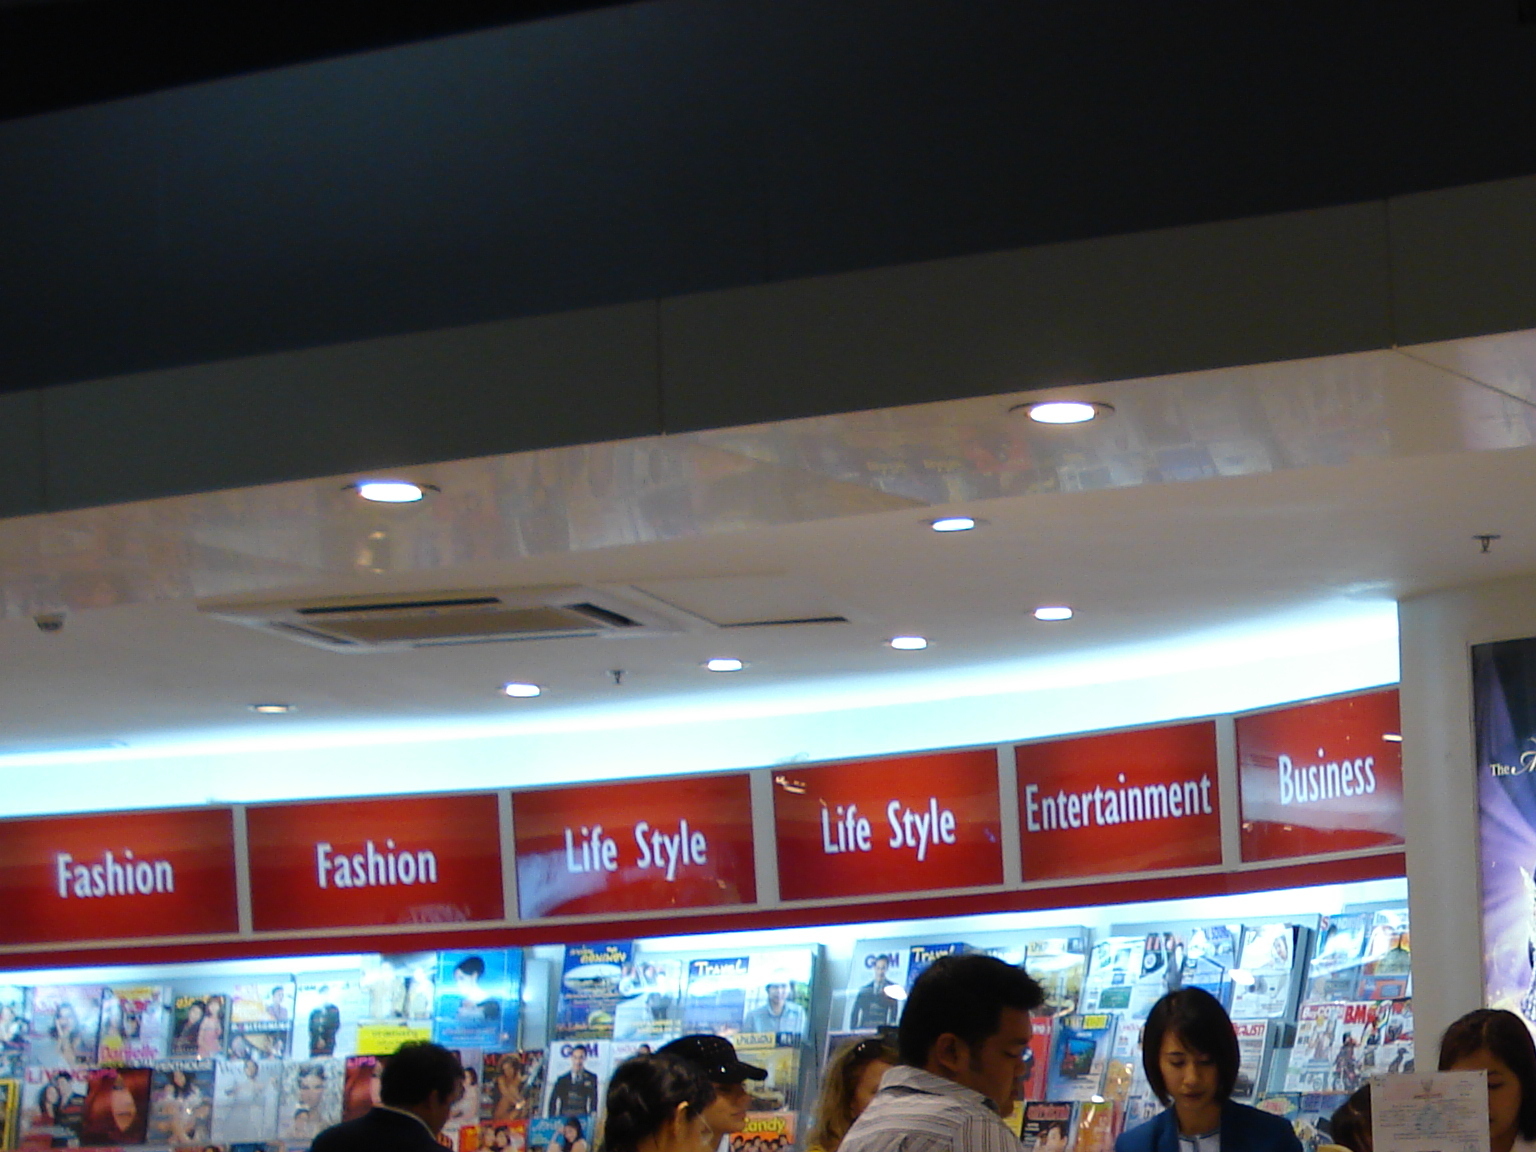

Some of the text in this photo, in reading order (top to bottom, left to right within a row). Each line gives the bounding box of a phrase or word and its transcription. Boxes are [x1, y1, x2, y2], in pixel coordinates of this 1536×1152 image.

[1278, 747, 1377, 805] Business
[1490, 763, 1510, 777] The
[821, 798, 956, 862] Life Style
[1025, 773, 1212, 833] Entertainment
[57, 850, 175, 898] Fashion
[316, 838, 438, 889] Fashion
[565, 819, 708, 881] Life Style
